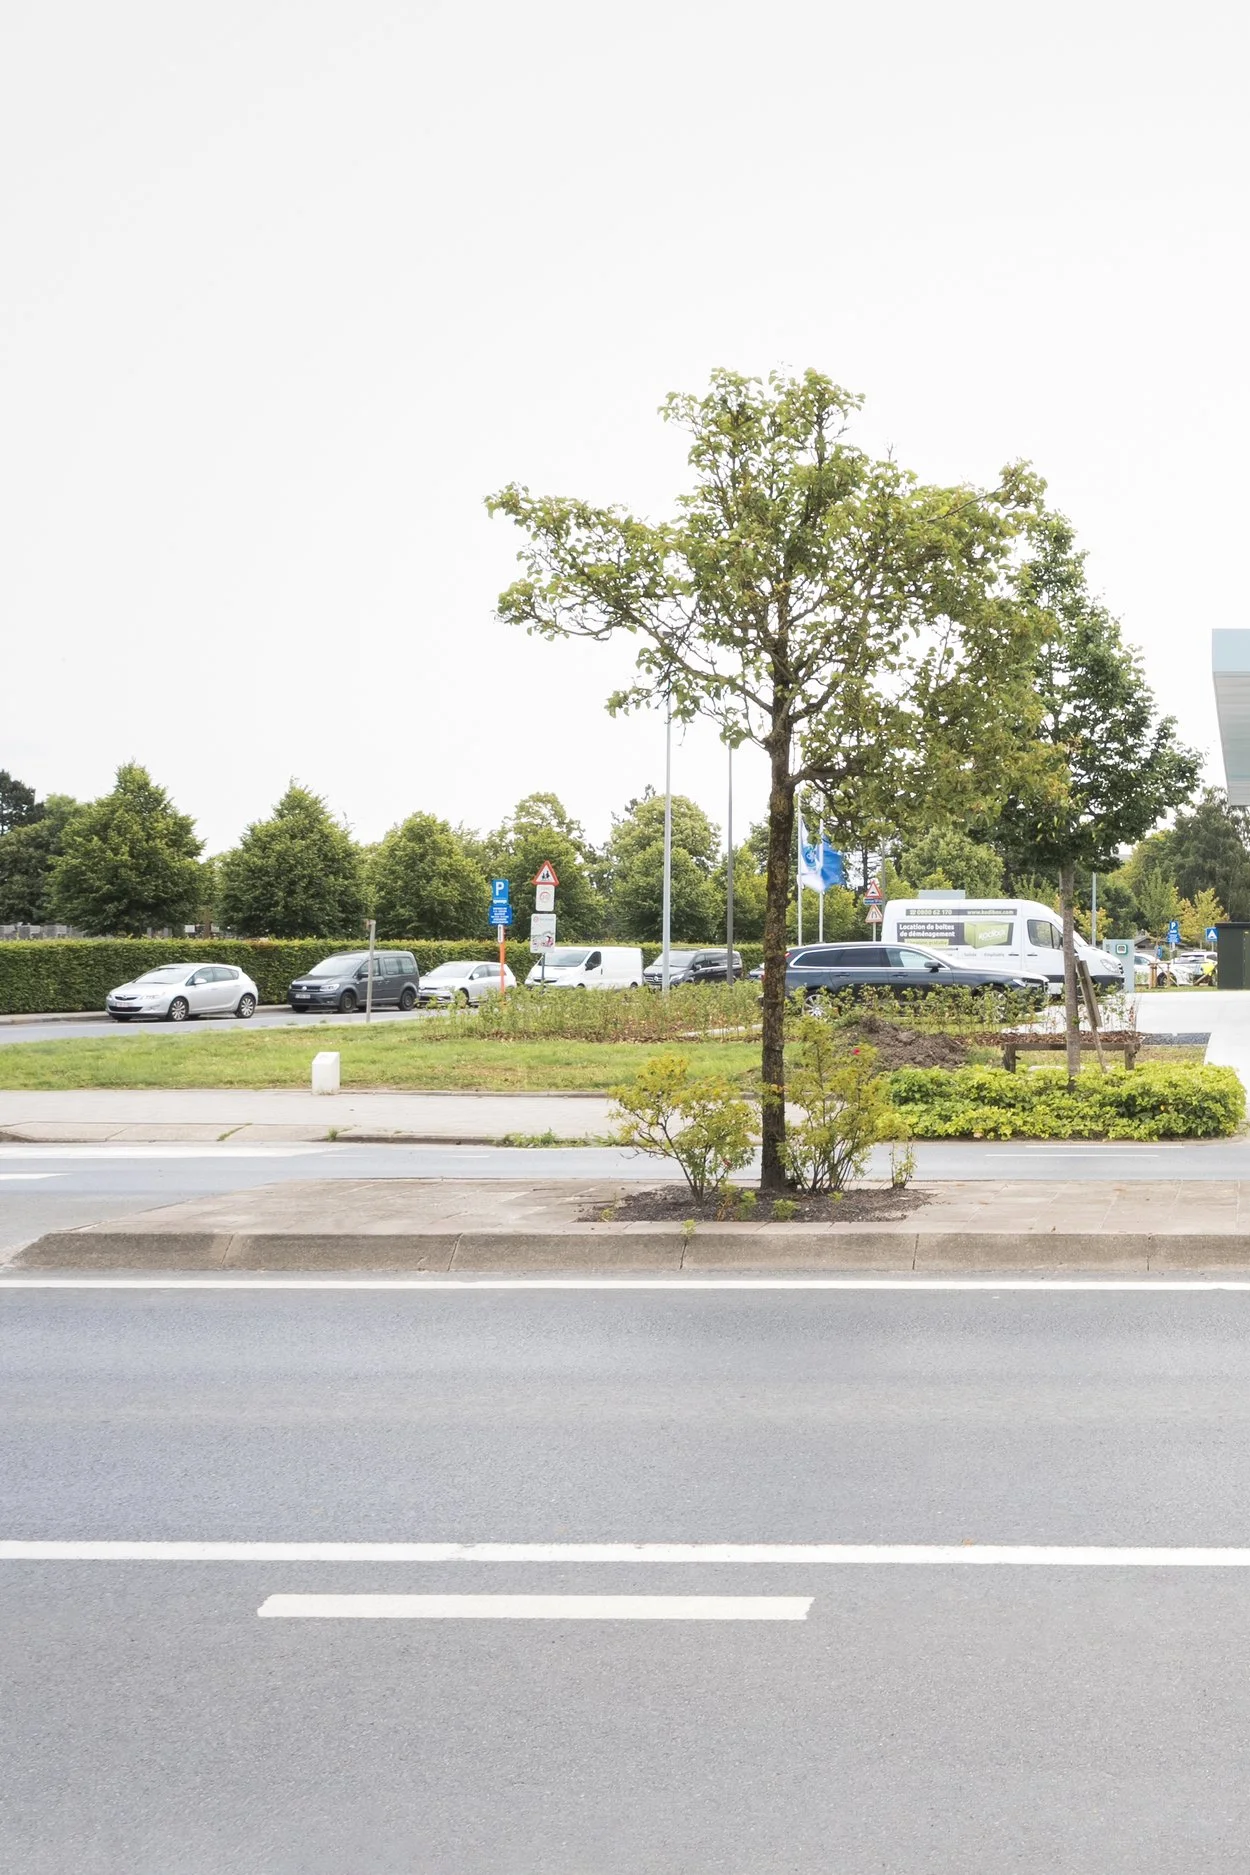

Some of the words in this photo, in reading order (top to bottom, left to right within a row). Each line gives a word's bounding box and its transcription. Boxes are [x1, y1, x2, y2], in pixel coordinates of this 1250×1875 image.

[496, 881, 504, 896] P
[899, 923, 925, 931] Location
[926, 923, 935, 931] de
[935, 923, 955, 931] boîtes
[1171, 921, 1176, 929] P
[899, 930, 908, 938] de
[908, 930, 956, 939] déménagement
